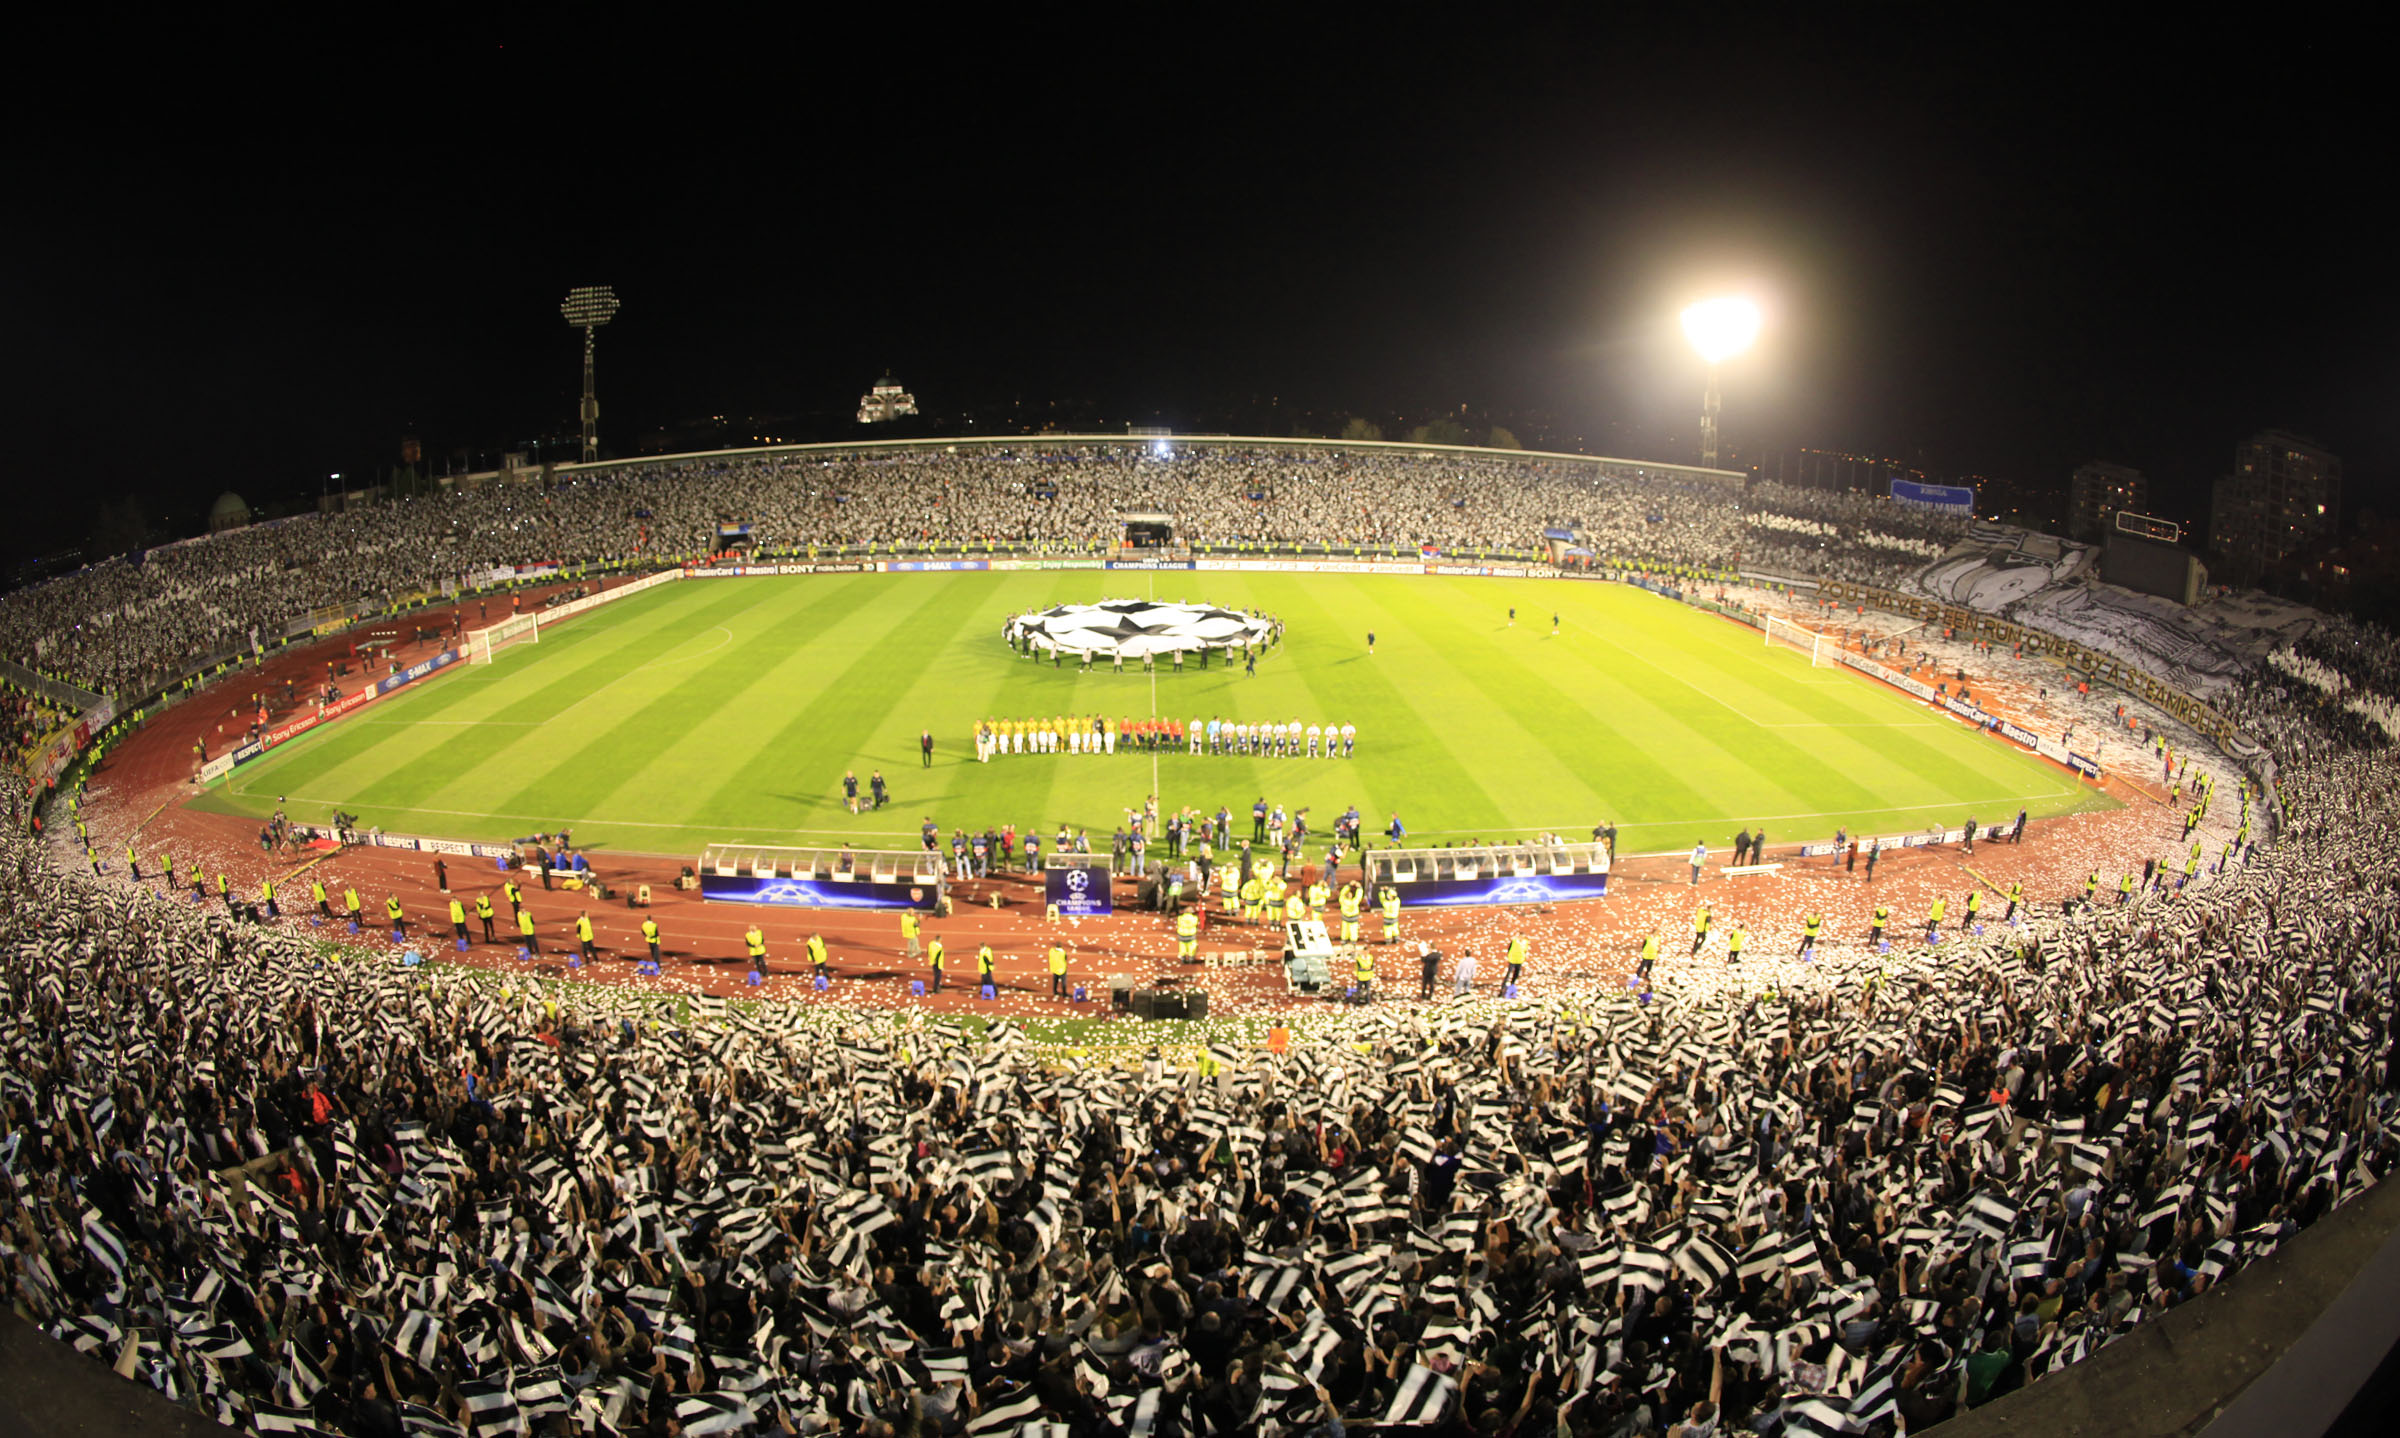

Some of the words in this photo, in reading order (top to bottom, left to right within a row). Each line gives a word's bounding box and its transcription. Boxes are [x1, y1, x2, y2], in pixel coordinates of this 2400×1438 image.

[695, 566, 734, 578] MasterCard
[745, 565, 777, 576] Maestro
[779, 564, 815, 575] SONY
[922, 561, 953, 571] S-MAX
[1042, 561, 1061, 571] Enjoy
[1112, 562, 1156, 570] CHAMPIONS
[1158, 562, 1189, 570] LEAGUE
[1437, 565, 1481, 576] MasterCard
[1493, 567, 1523, 577] Maestro
[1526, 568, 1562, 578] SONY
[549, 606, 572, 621] PS3
[408, 661, 432, 680] S-MAX
[1816, 579, 1860, 602] YOU
[1865, 590, 1923, 617] HAVE
[1926, 601, 1980, 633] BEEN
[1983, 617, 2024, 643] RUN
[2027, 633, 2079, 664] OVER
[2081, 651, 2105, 671] BY
[2107, 663, 2120, 683] A
[2125, 668, 2233, 750] STEAMROLLER
[1847, 653, 1880, 675] UniCredit
[1890, 672, 1925, 696] UniCredit
[325, 703, 342, 717] Sony
[342, 692, 366, 710] Ericsson
[272, 729, 291, 744] Sony
[289, 715, 317, 736] Ericsson
[2002, 722, 2038, 747] Maestro
[237, 744, 262, 762] RESPECT
[2072, 756, 2098, 775] RESPECT
[383, 834, 416, 849] RESPECT
[430, 841, 467, 854] RESPECT
